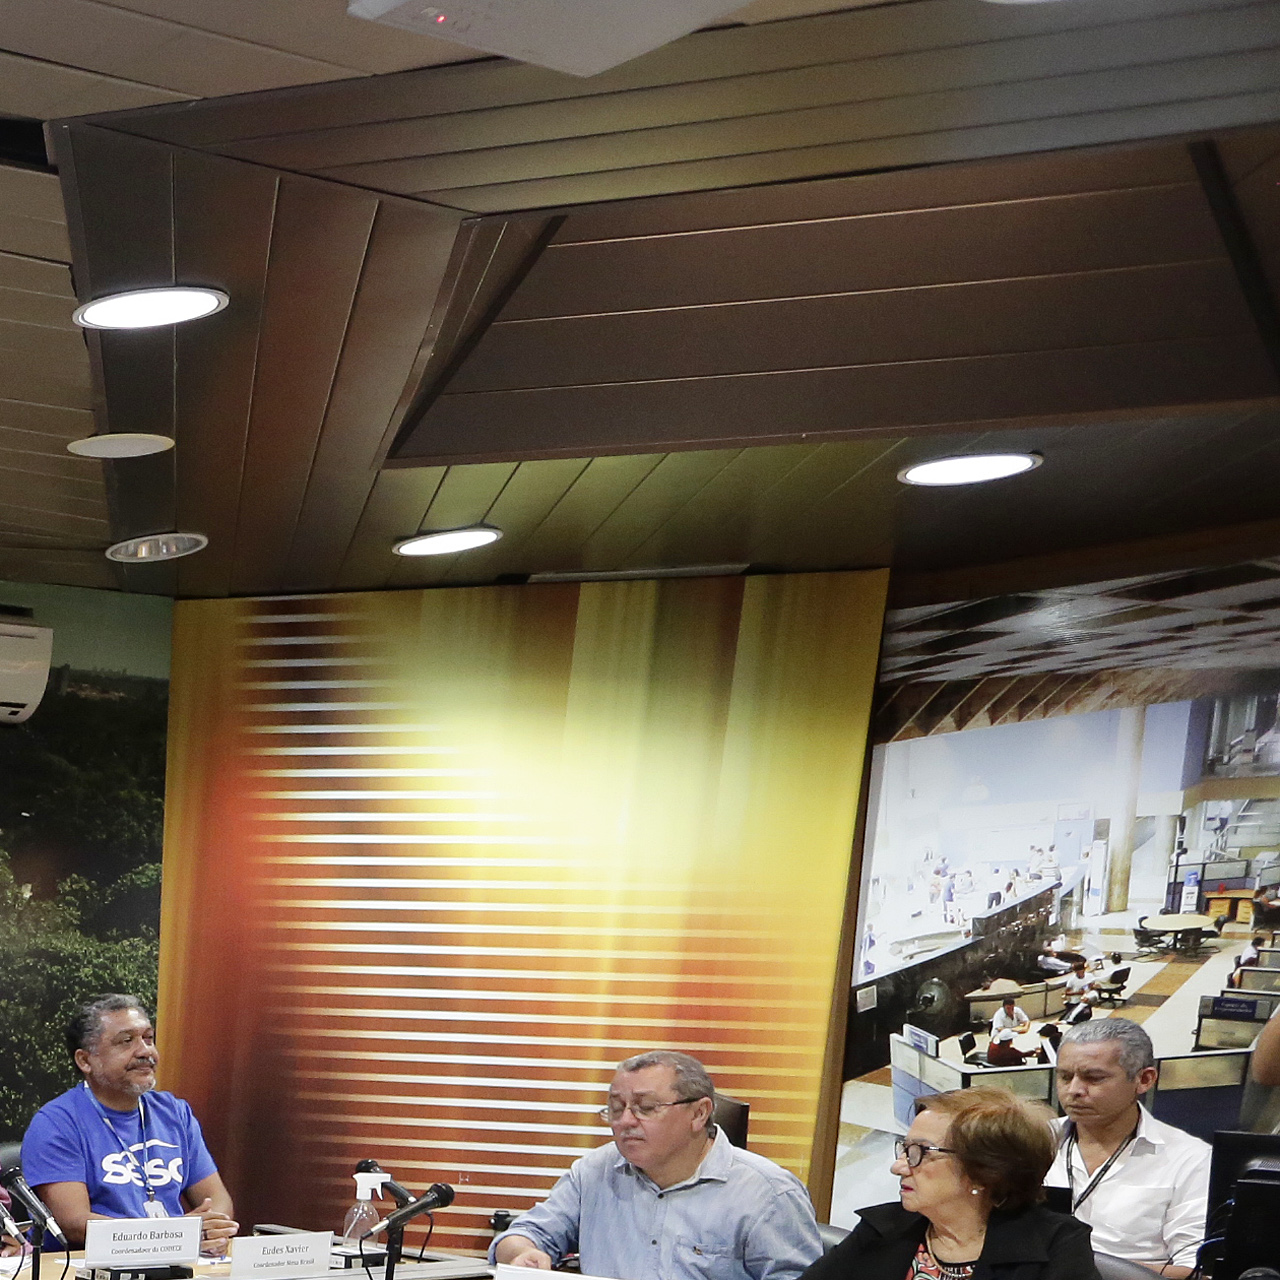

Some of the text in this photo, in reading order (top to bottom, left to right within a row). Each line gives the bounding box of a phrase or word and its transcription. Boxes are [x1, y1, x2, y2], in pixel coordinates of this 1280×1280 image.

[112, 1230, 183, 1242] Eduardo Barbosa
[285, 1244, 309, 1254] Xavier
